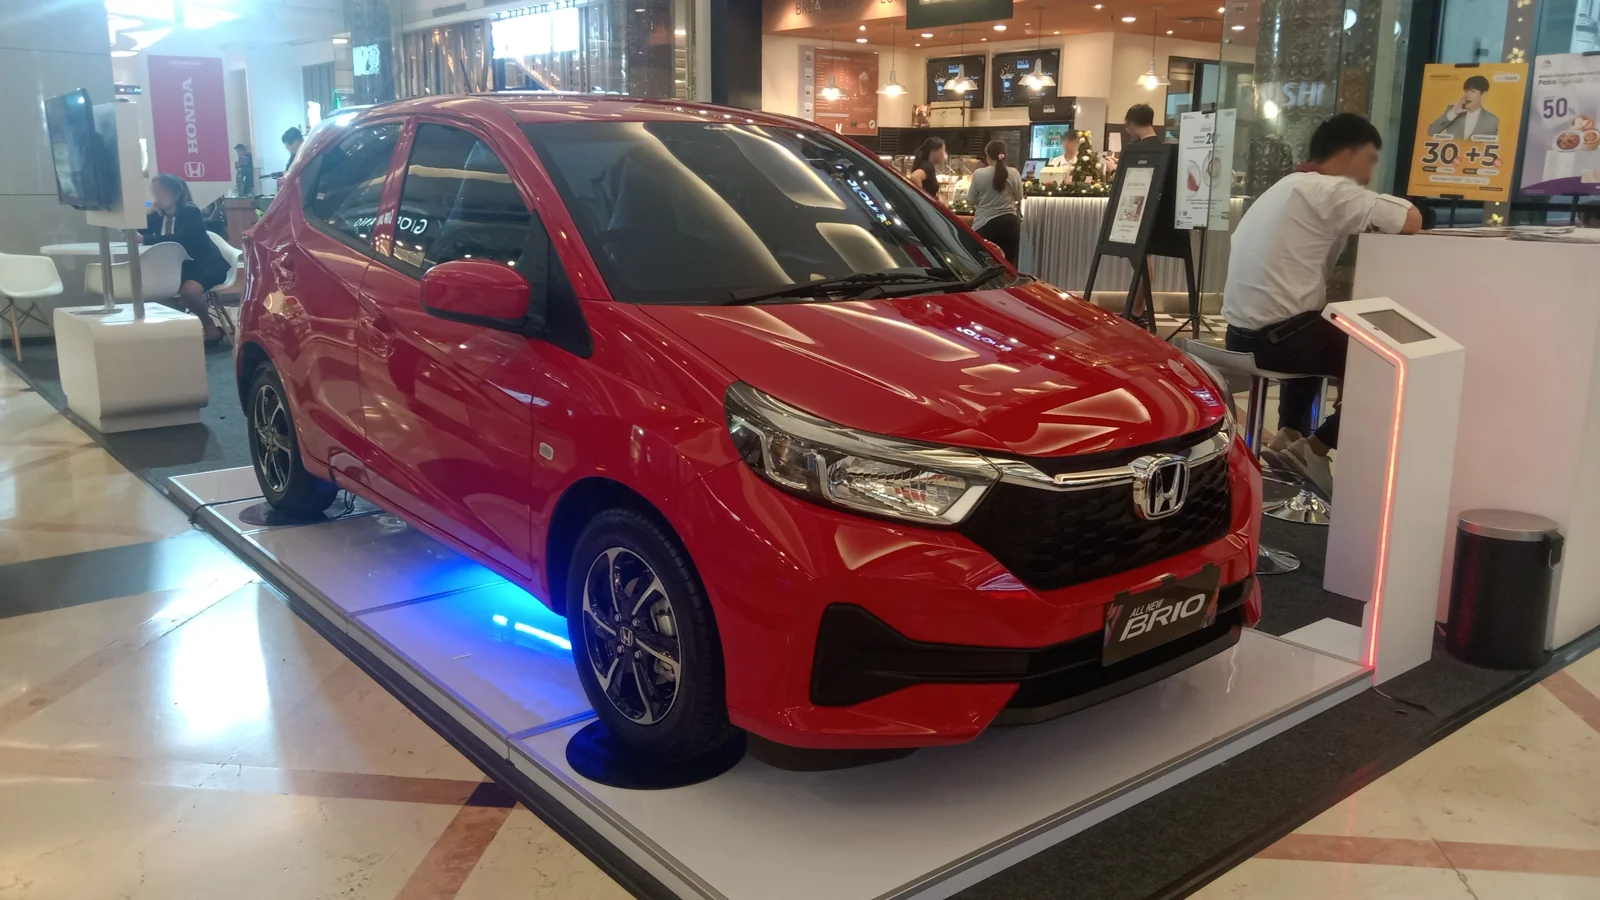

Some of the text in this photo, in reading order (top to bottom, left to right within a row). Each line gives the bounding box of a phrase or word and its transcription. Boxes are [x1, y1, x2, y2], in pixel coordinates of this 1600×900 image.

[182, 76, 199, 154] HONDA
[1119, 593, 1206, 642] BRIO
[1130, 599, 1164, 618] ALL NEW
